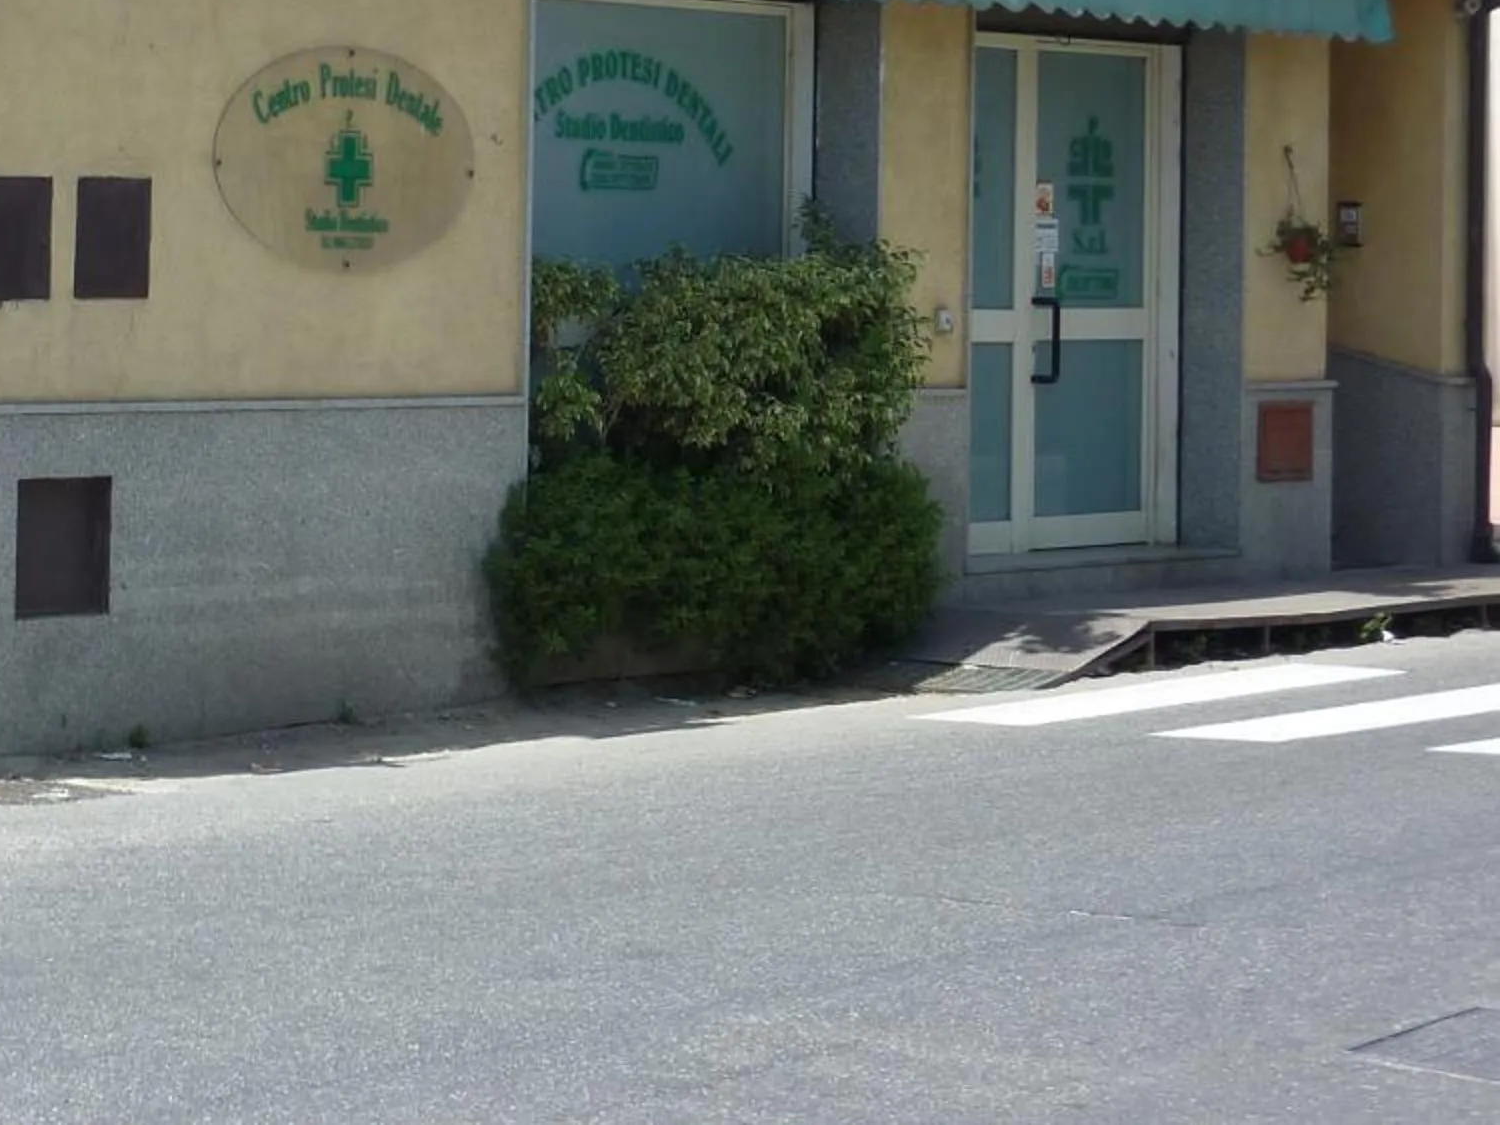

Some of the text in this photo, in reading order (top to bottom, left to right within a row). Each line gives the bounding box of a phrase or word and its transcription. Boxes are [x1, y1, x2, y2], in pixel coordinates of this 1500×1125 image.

[252, 79, 311, 124] Centro
[319, 62, 378, 100] Protesi
[577, 48, 663, 89] PROTESI
[664, 68, 734, 167] DENTALI
